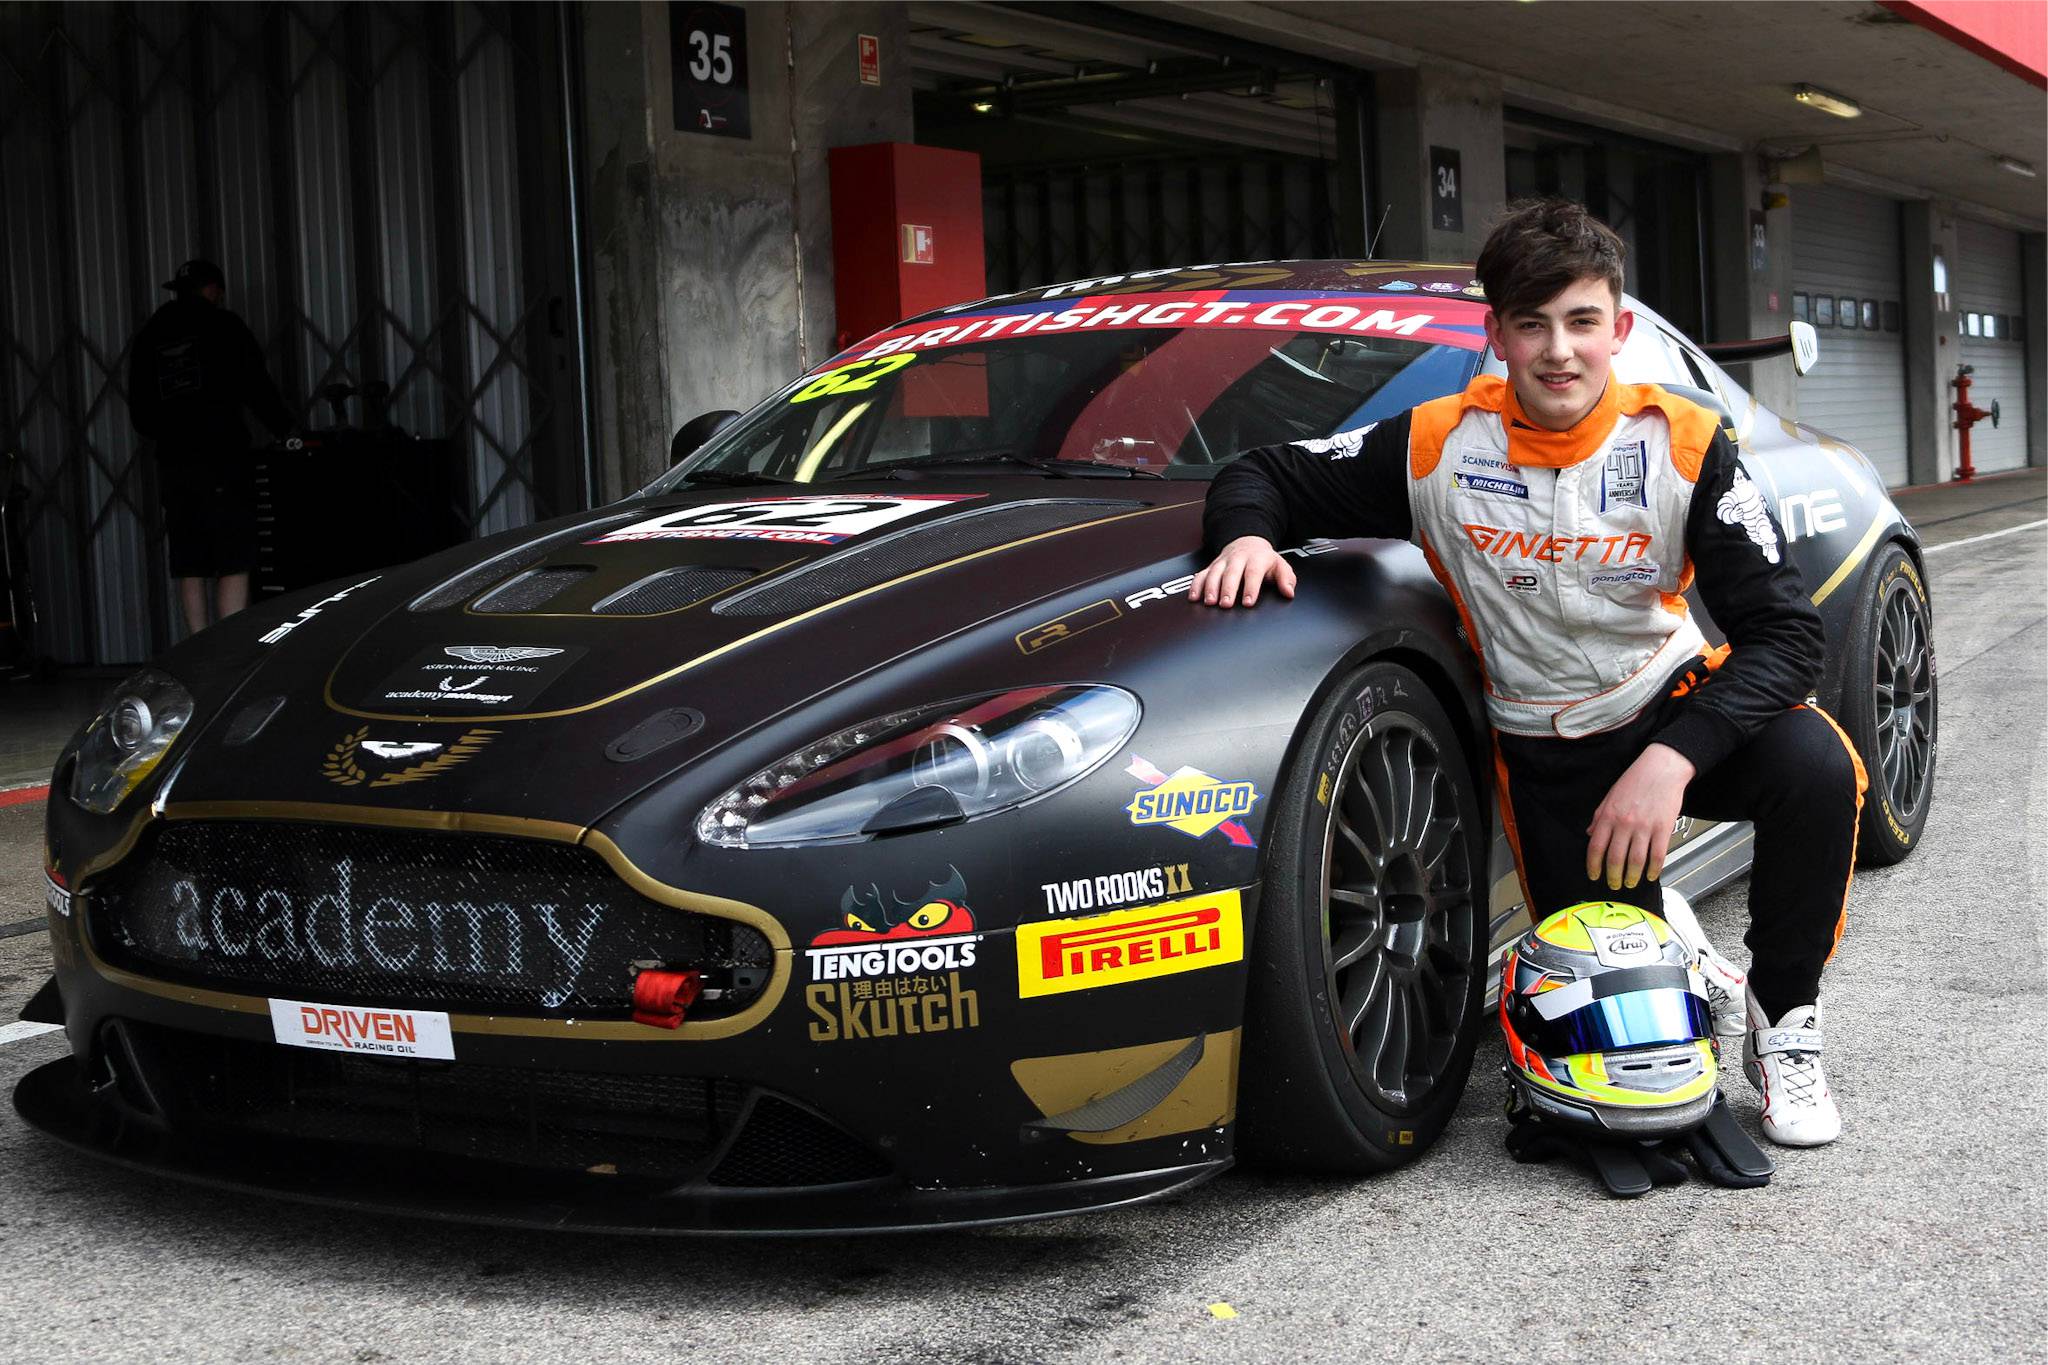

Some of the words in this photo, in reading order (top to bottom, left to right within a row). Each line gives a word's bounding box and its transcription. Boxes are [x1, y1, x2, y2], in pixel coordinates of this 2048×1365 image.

[689, 30, 733, 84] 35
[1438, 166, 1456, 198] 34
[855, 302, 1435, 362] BRITISHGT.COM
[790, 352, 917, 403] 62
[1607, 453, 1641, 480] 40
[660, 501, 902, 528] 62
[1463, 524, 1653, 563] GINETTA
[421, 663, 455, 671] ASTON
[456, 663, 494, 671] MARTIN
[496, 664, 540, 673] RACING
[1136, 786, 1250, 820] SUNOCO
[1041, 878, 1094, 914] TWO
[1095, 867, 1165, 907] ROOKS
[172, 856, 606, 1007] academy
[1040, 907, 1221, 979] PIRELLI
[805, 971, 980, 1042] Skutch
[853, 975, 947, 999] 理由はない
[301, 1006, 417, 1047] DRIVEN
[354, 1042, 394, 1052] RACING
[397, 1045, 416, 1054] OIL
